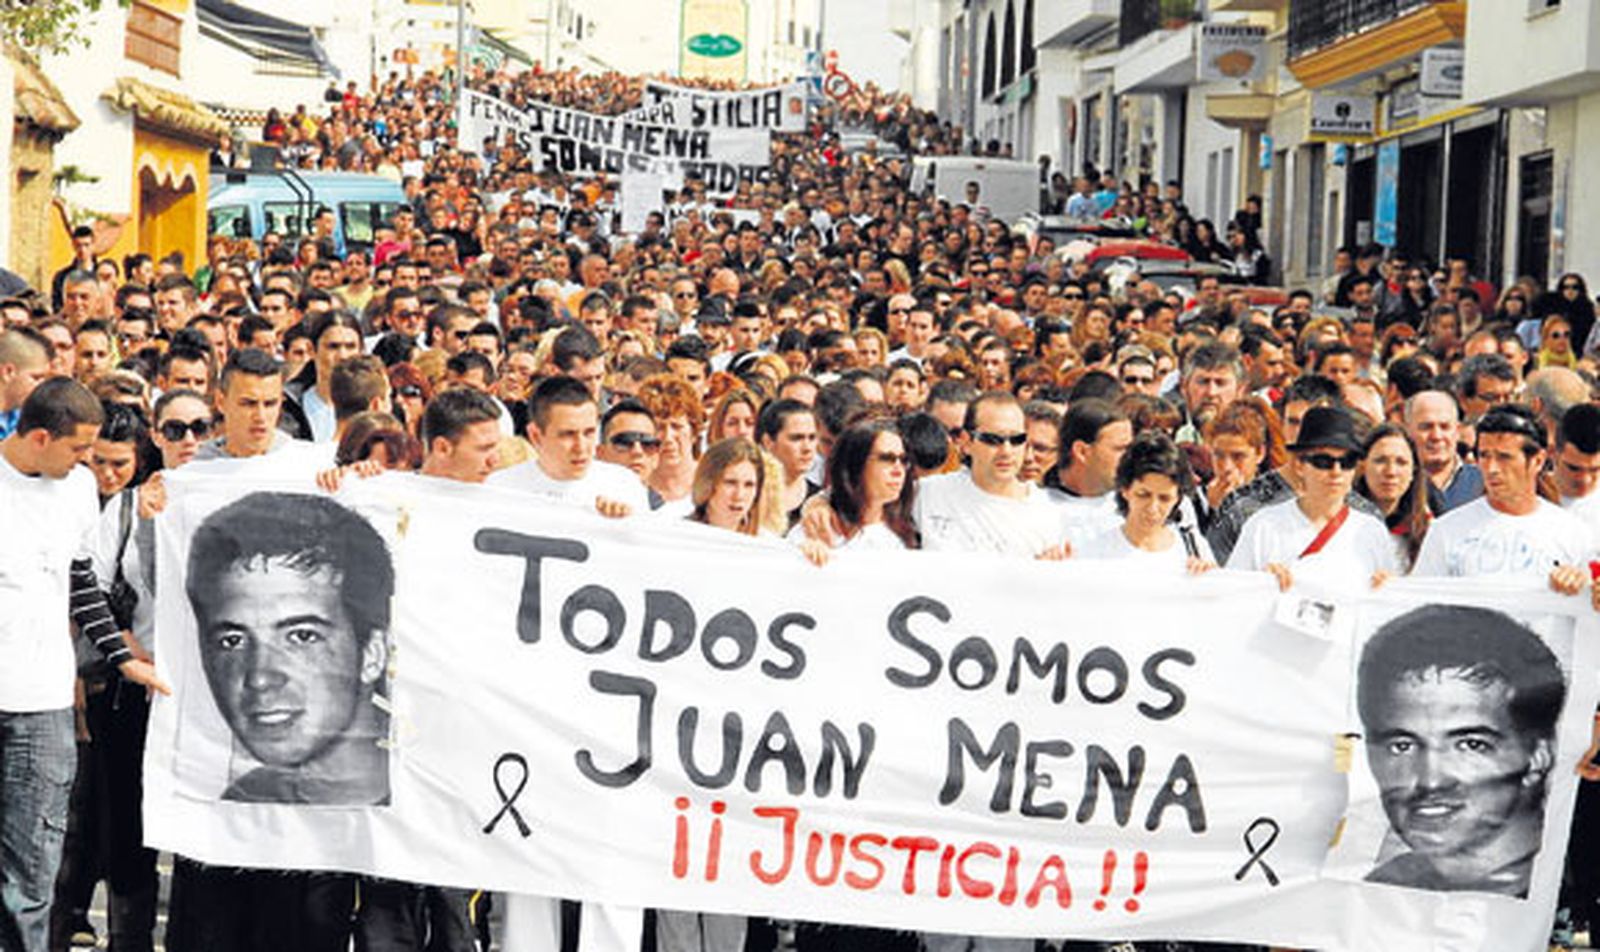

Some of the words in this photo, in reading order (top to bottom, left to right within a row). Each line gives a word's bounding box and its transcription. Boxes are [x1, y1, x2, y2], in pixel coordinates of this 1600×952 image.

[526, 103, 616, 144] JUAN
[620, 122, 711, 159] MENA
[541, 135, 650, 176] SOMOS
[574, 669, 876, 801] JUAN
[938, 717, 1208, 834] MENA
